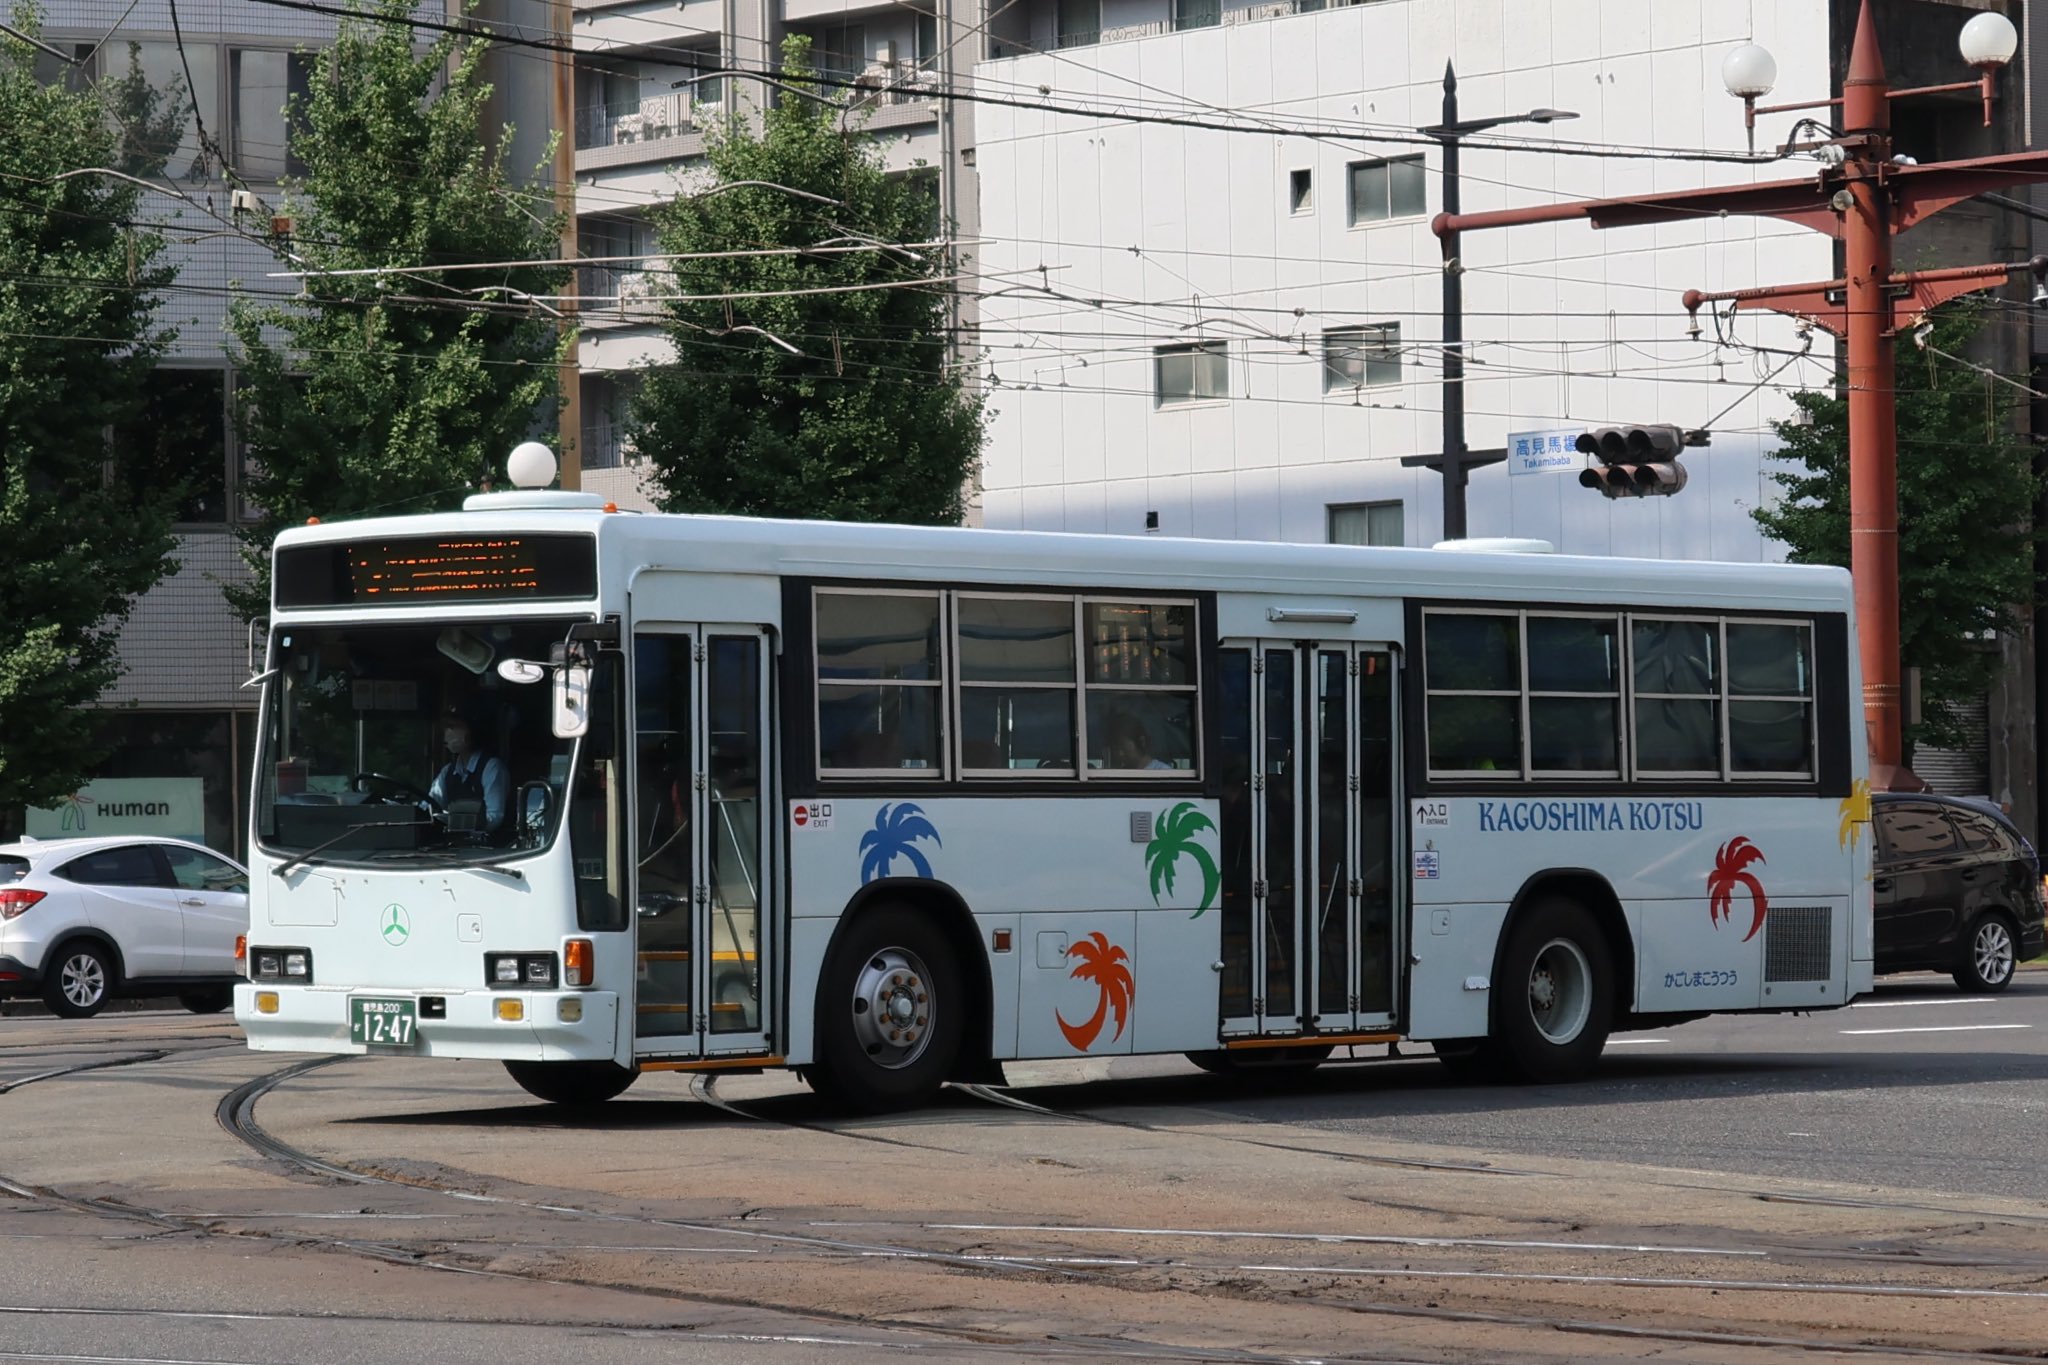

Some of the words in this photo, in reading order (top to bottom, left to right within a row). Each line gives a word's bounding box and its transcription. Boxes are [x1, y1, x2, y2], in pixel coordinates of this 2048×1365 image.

[1516, 435, 1577, 457] 高見馬場
[1523, 456, 1571, 470] Takamibaba
[97, 801, 170, 817] Human
[809, 803, 832, 818] 出口
[1428, 803, 1447, 817] 入口
[813, 819, 829, 828] EXIT
[1479, 802, 1624, 832] KAGOSHIMA
[1629, 802, 1703, 832] KOTSU
[1664, 970, 1738, 988] かごしまこうつう
